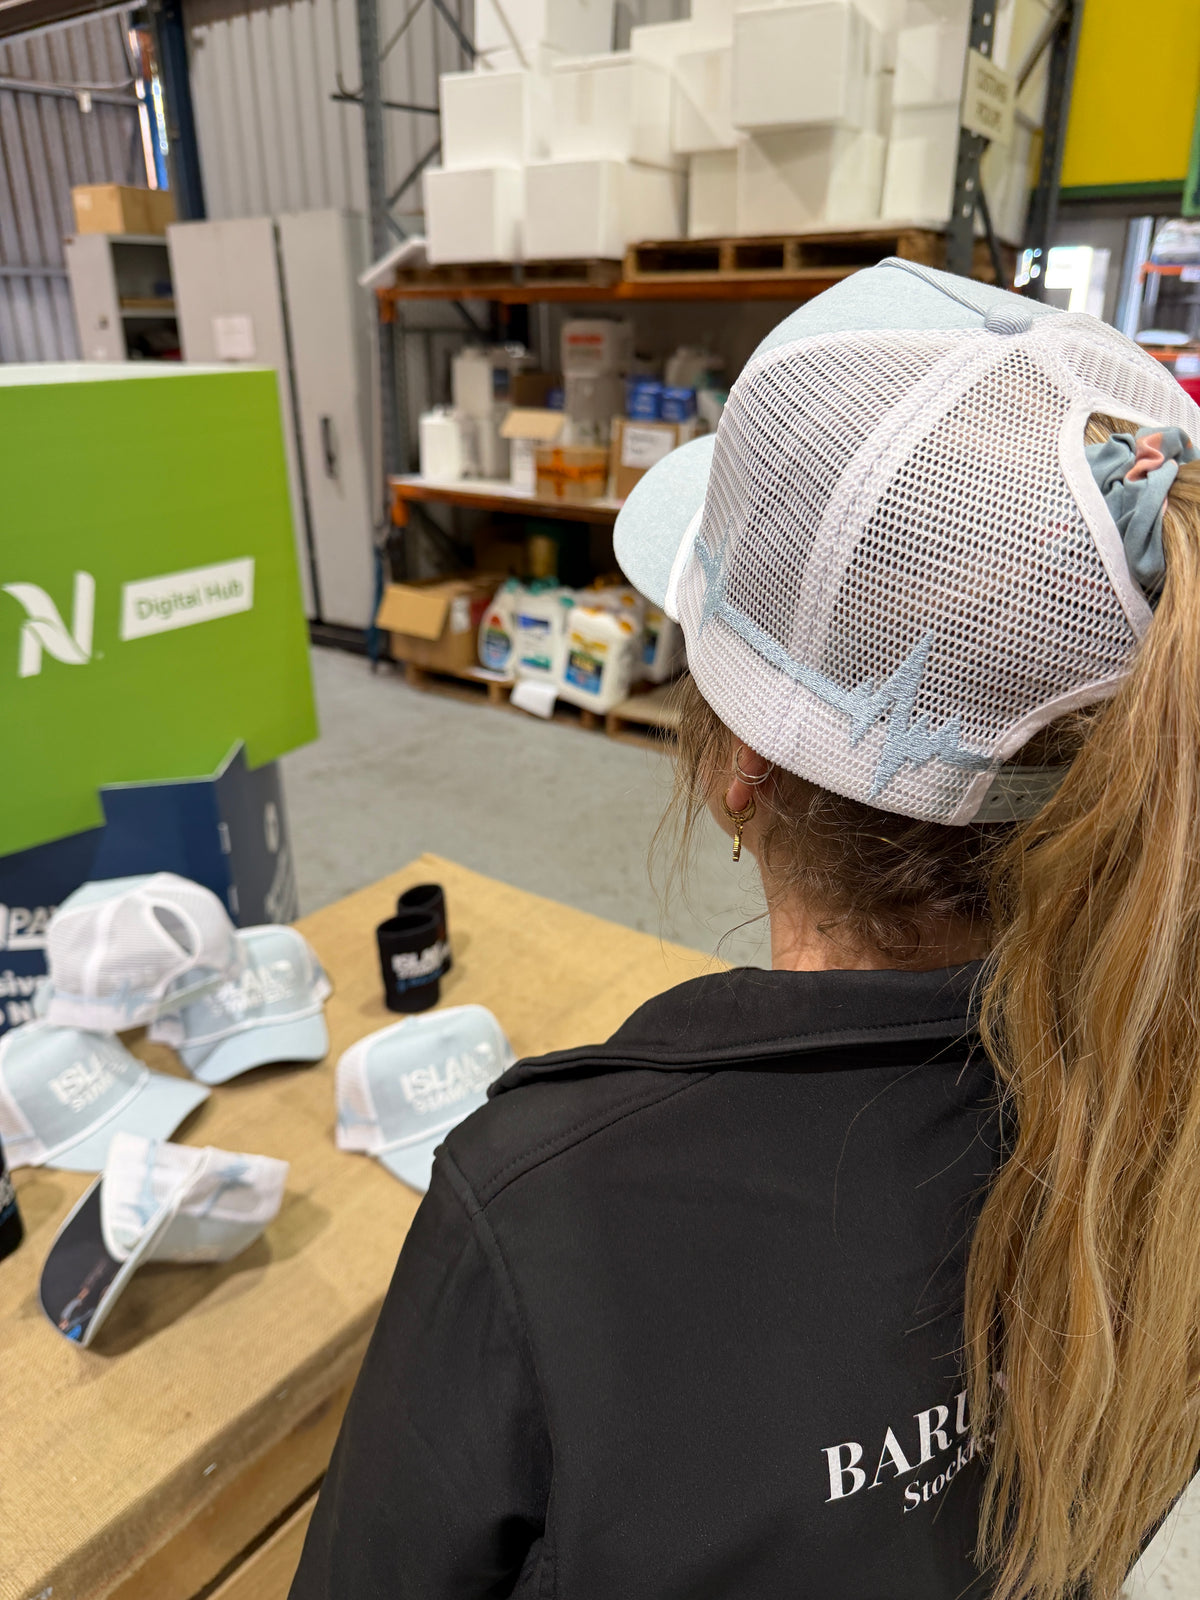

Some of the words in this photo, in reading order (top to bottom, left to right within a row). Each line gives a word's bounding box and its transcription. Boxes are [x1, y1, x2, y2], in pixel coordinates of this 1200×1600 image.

[136, 589, 202, 621] Digital
[205, 578, 244, 602] Hub
[9, 904, 57, 937] PA
